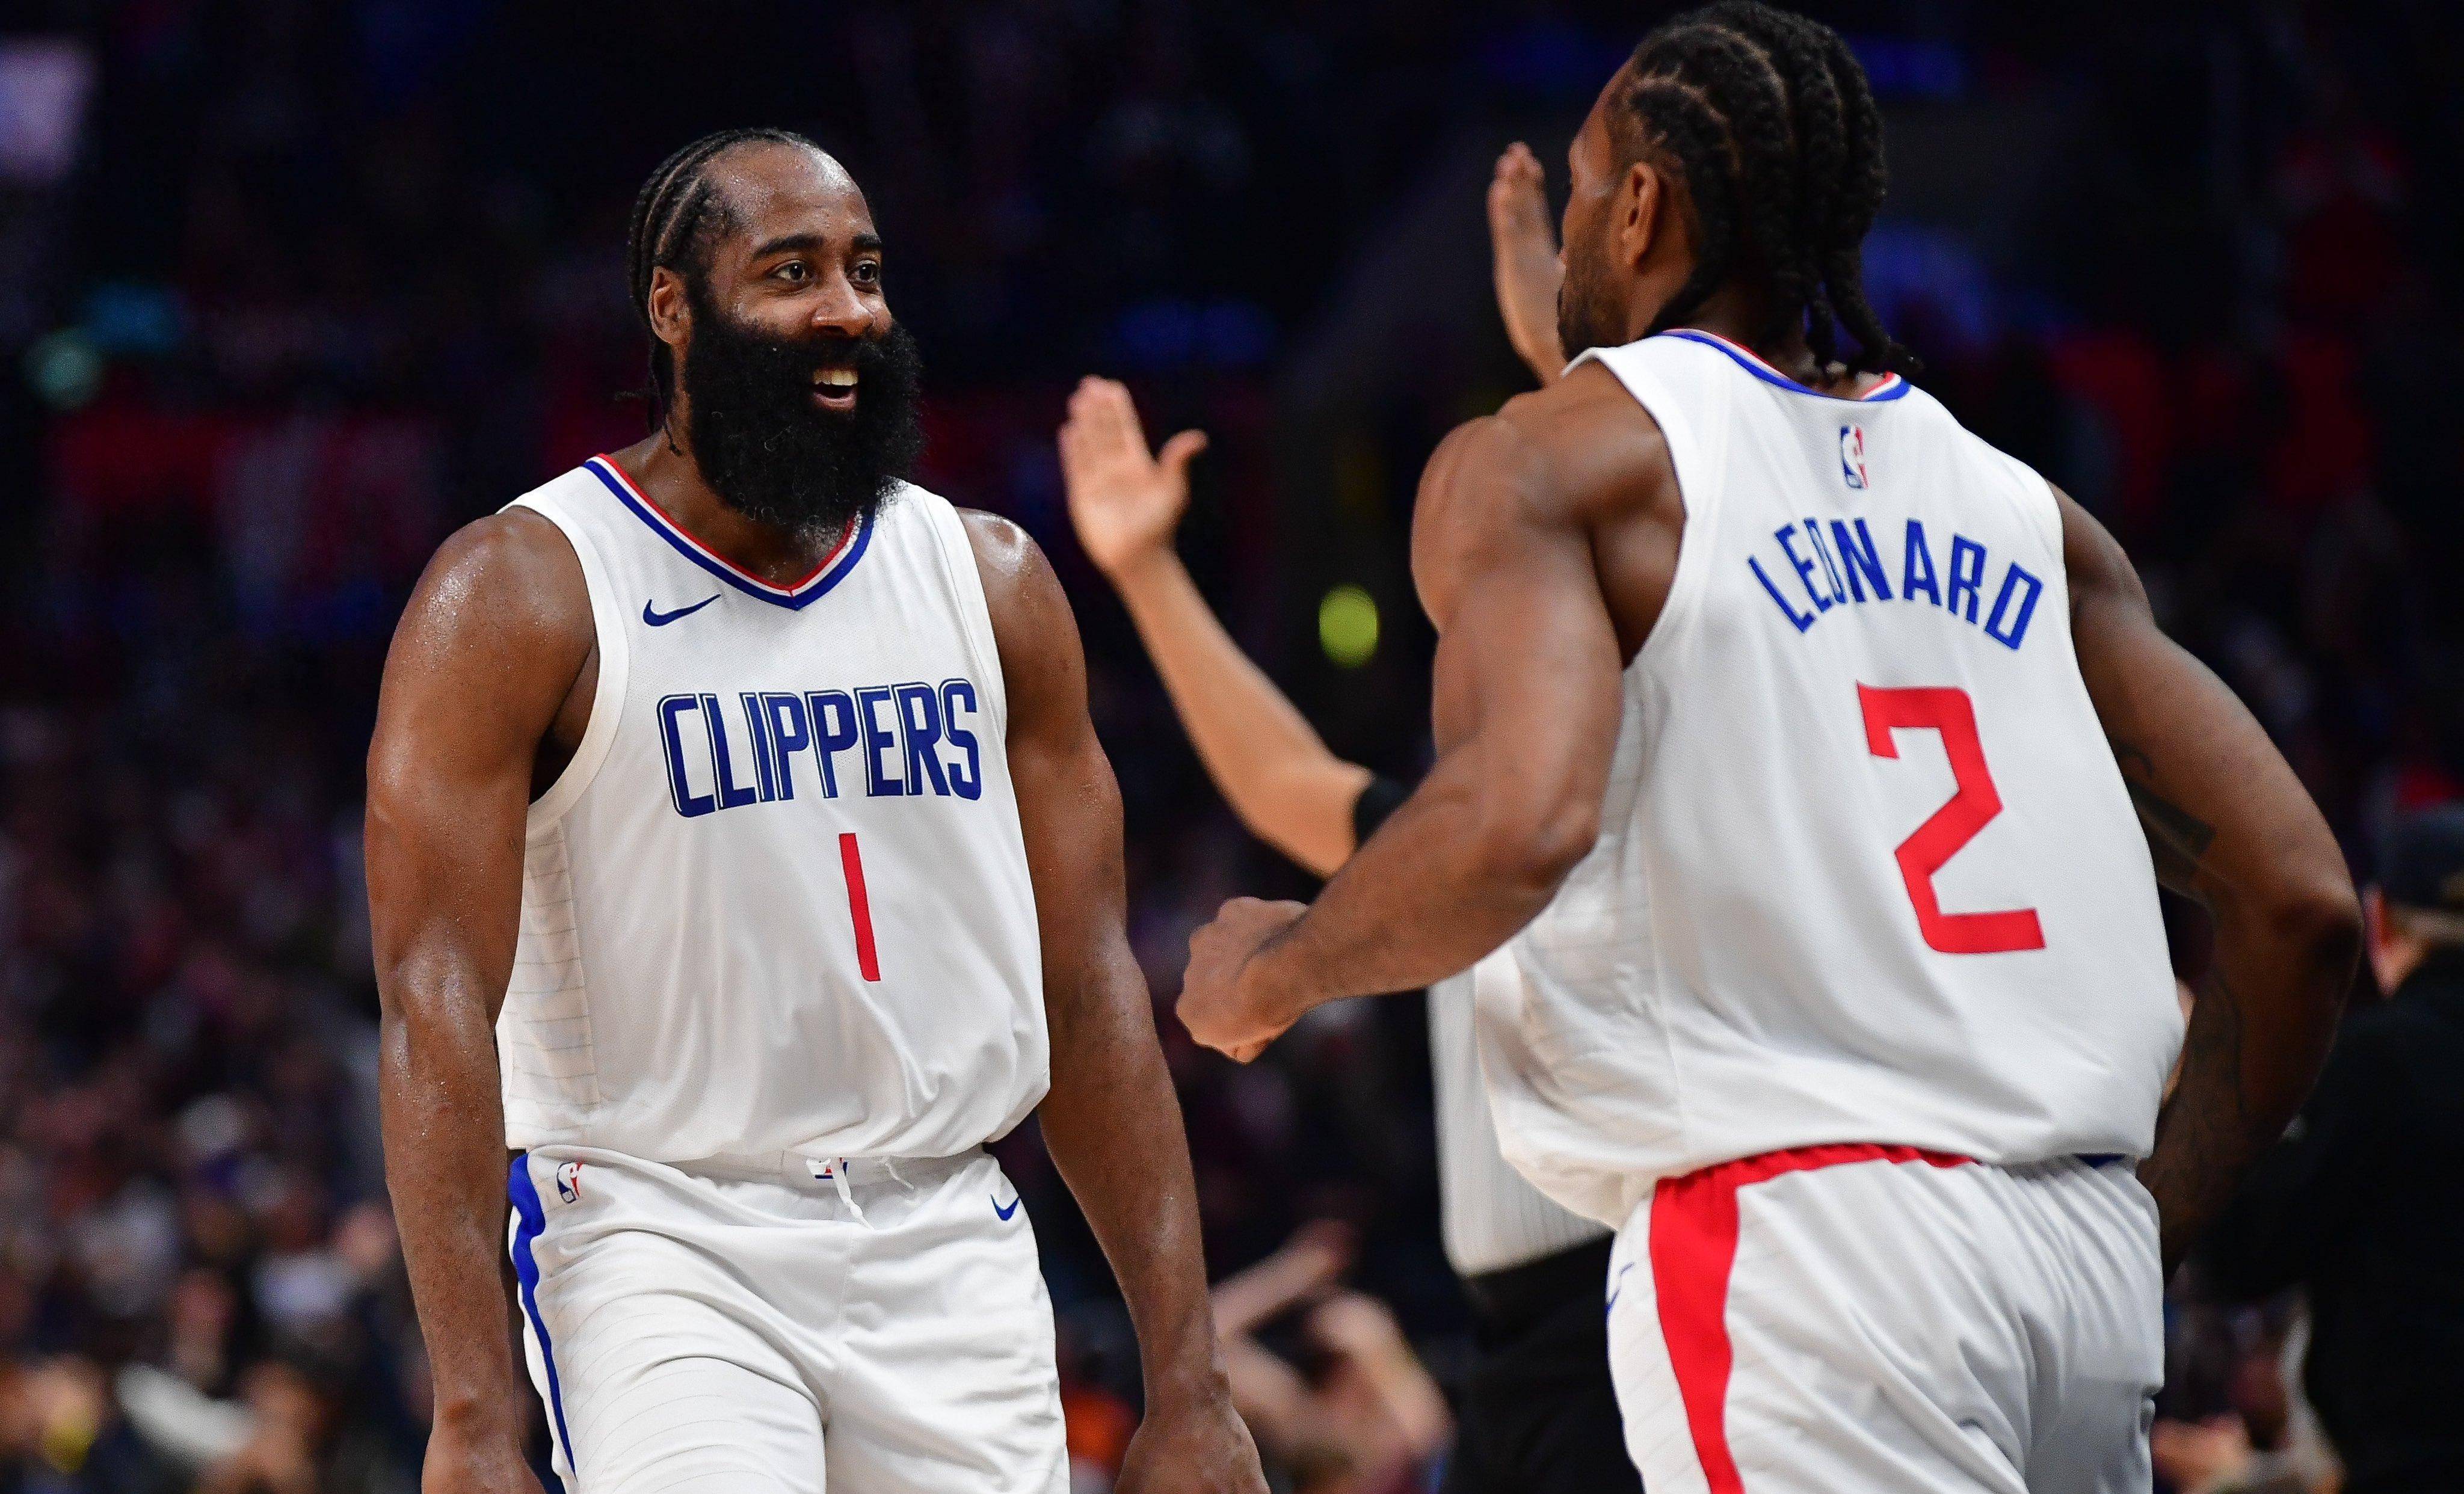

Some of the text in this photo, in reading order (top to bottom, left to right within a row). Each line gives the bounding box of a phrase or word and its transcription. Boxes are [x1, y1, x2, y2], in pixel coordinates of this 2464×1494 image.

[1748, 518, 2044, 651] LEONARD
[656, 678, 982, 818] CLIPPERS
[1857, 682, 2046, 954] 2
[839, 833, 881, 982] 1
